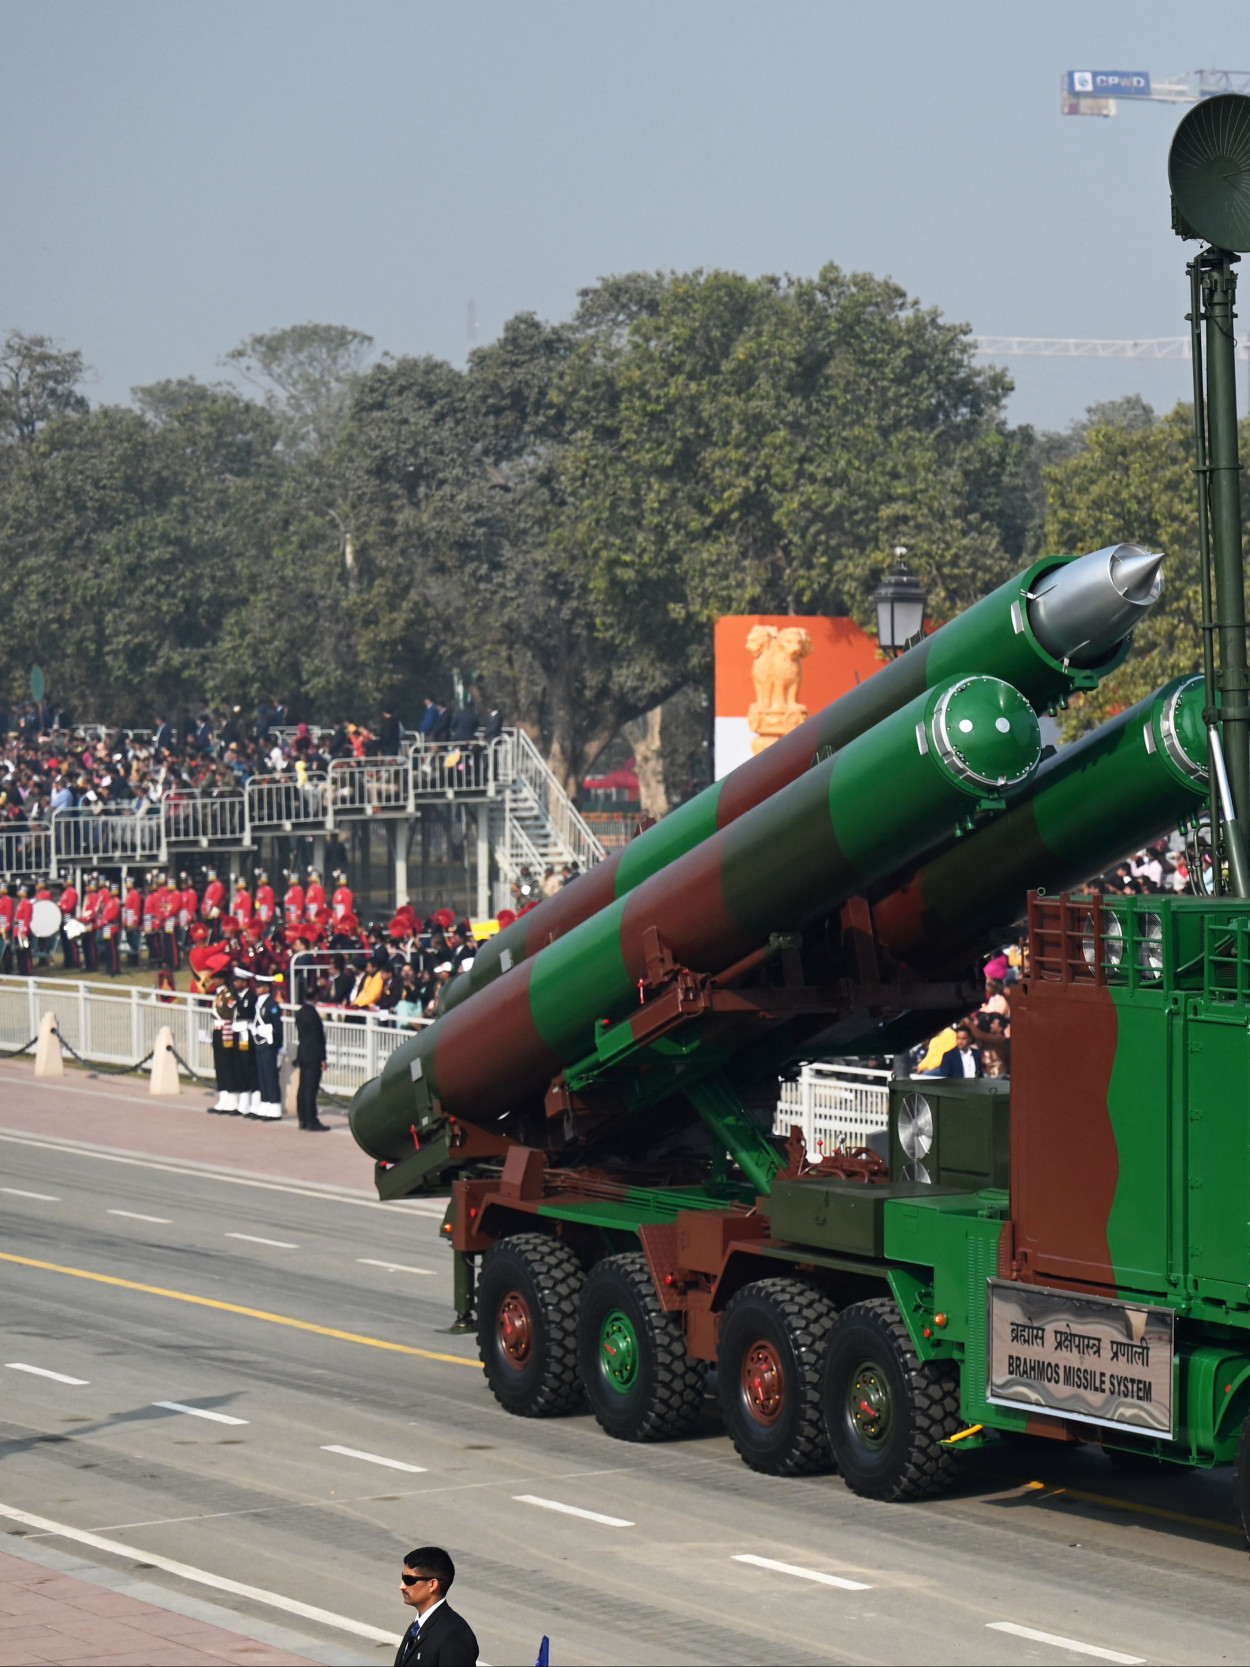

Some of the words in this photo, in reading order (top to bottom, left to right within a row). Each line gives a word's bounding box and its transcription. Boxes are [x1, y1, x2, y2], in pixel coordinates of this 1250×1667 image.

[1010, 1317, 1046, 1348] ब्रह्मोस
[1054, 1324, 1102, 1358] प्रक्षेपास्त्र
[1110, 1336, 1150, 1368] प्रणाली
[1008, 1355, 1060, 1385] BRAHMOS
[1063, 1365, 1106, 1393] MISSILE
[1109, 1374, 1152, 1403] SYSTEM
